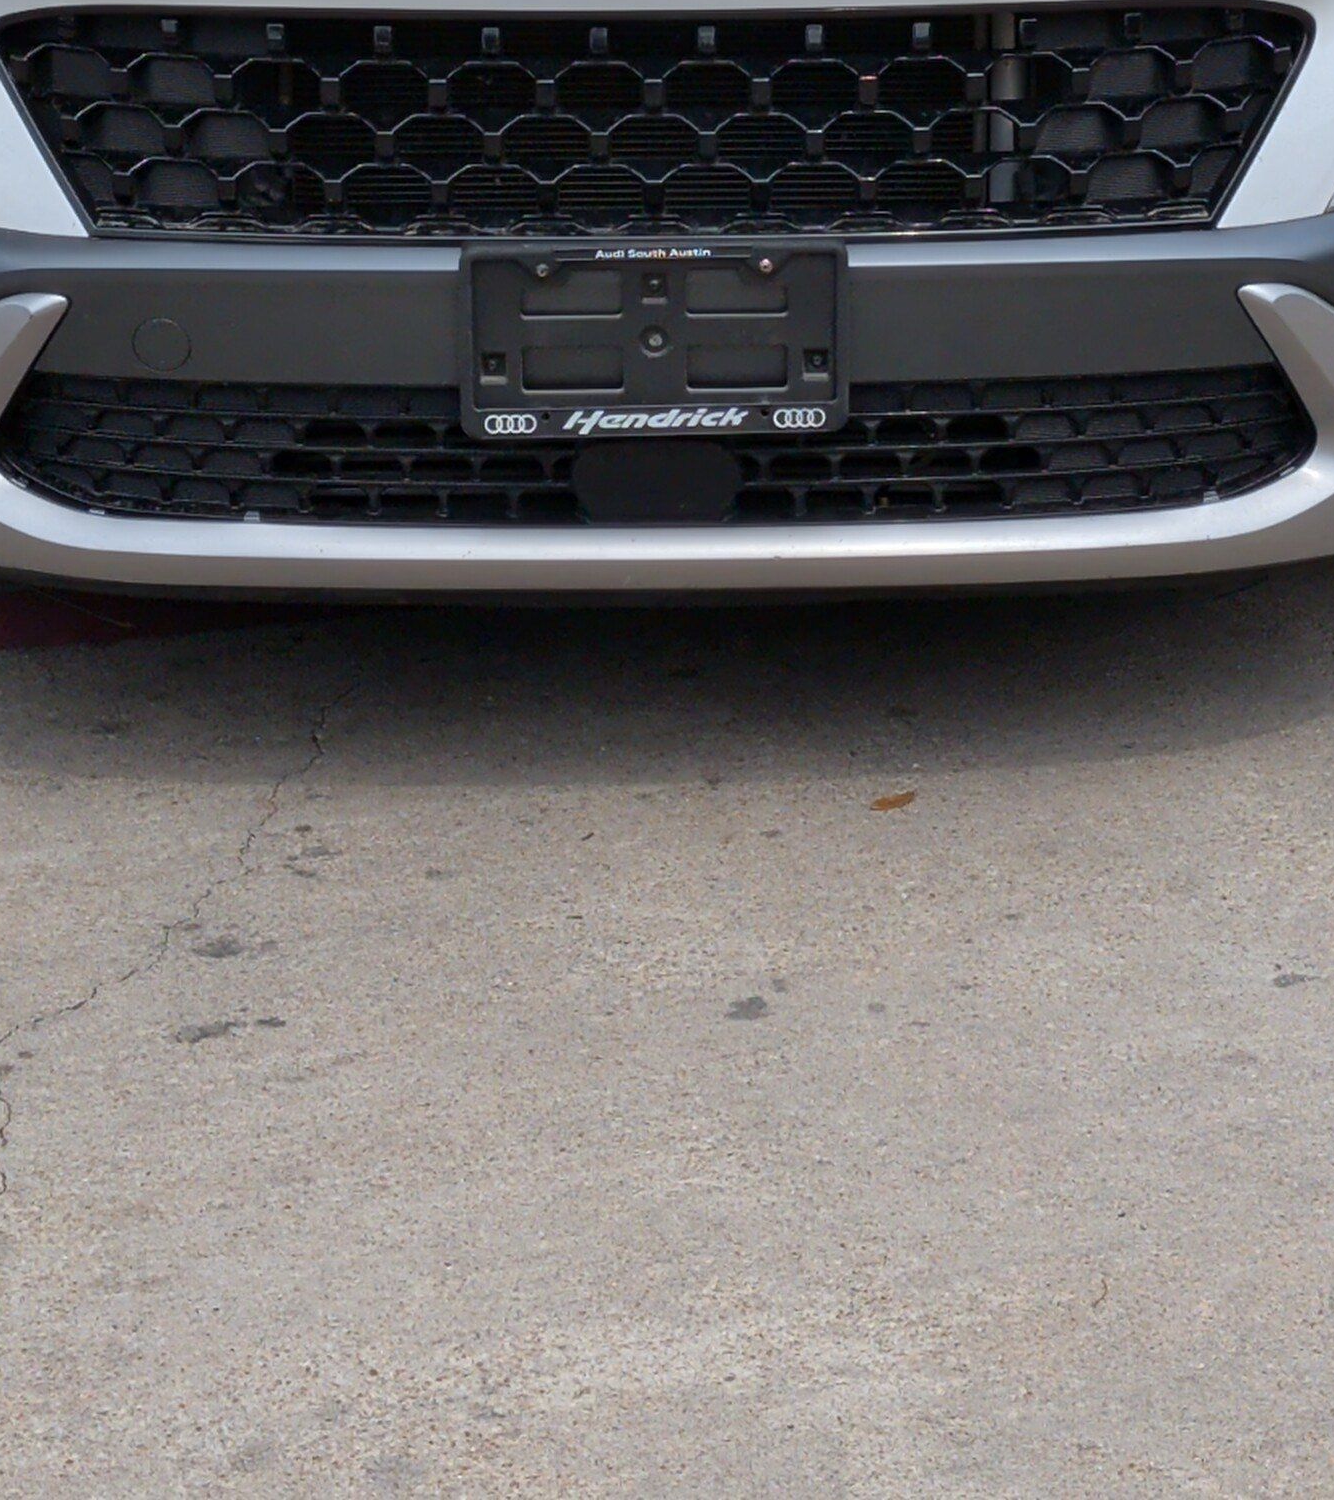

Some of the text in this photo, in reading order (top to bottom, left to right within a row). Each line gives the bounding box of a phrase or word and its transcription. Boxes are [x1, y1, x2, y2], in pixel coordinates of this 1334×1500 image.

[595, 247, 712, 259] Audi South Austin
[562, 406, 749, 435] Hendrick
